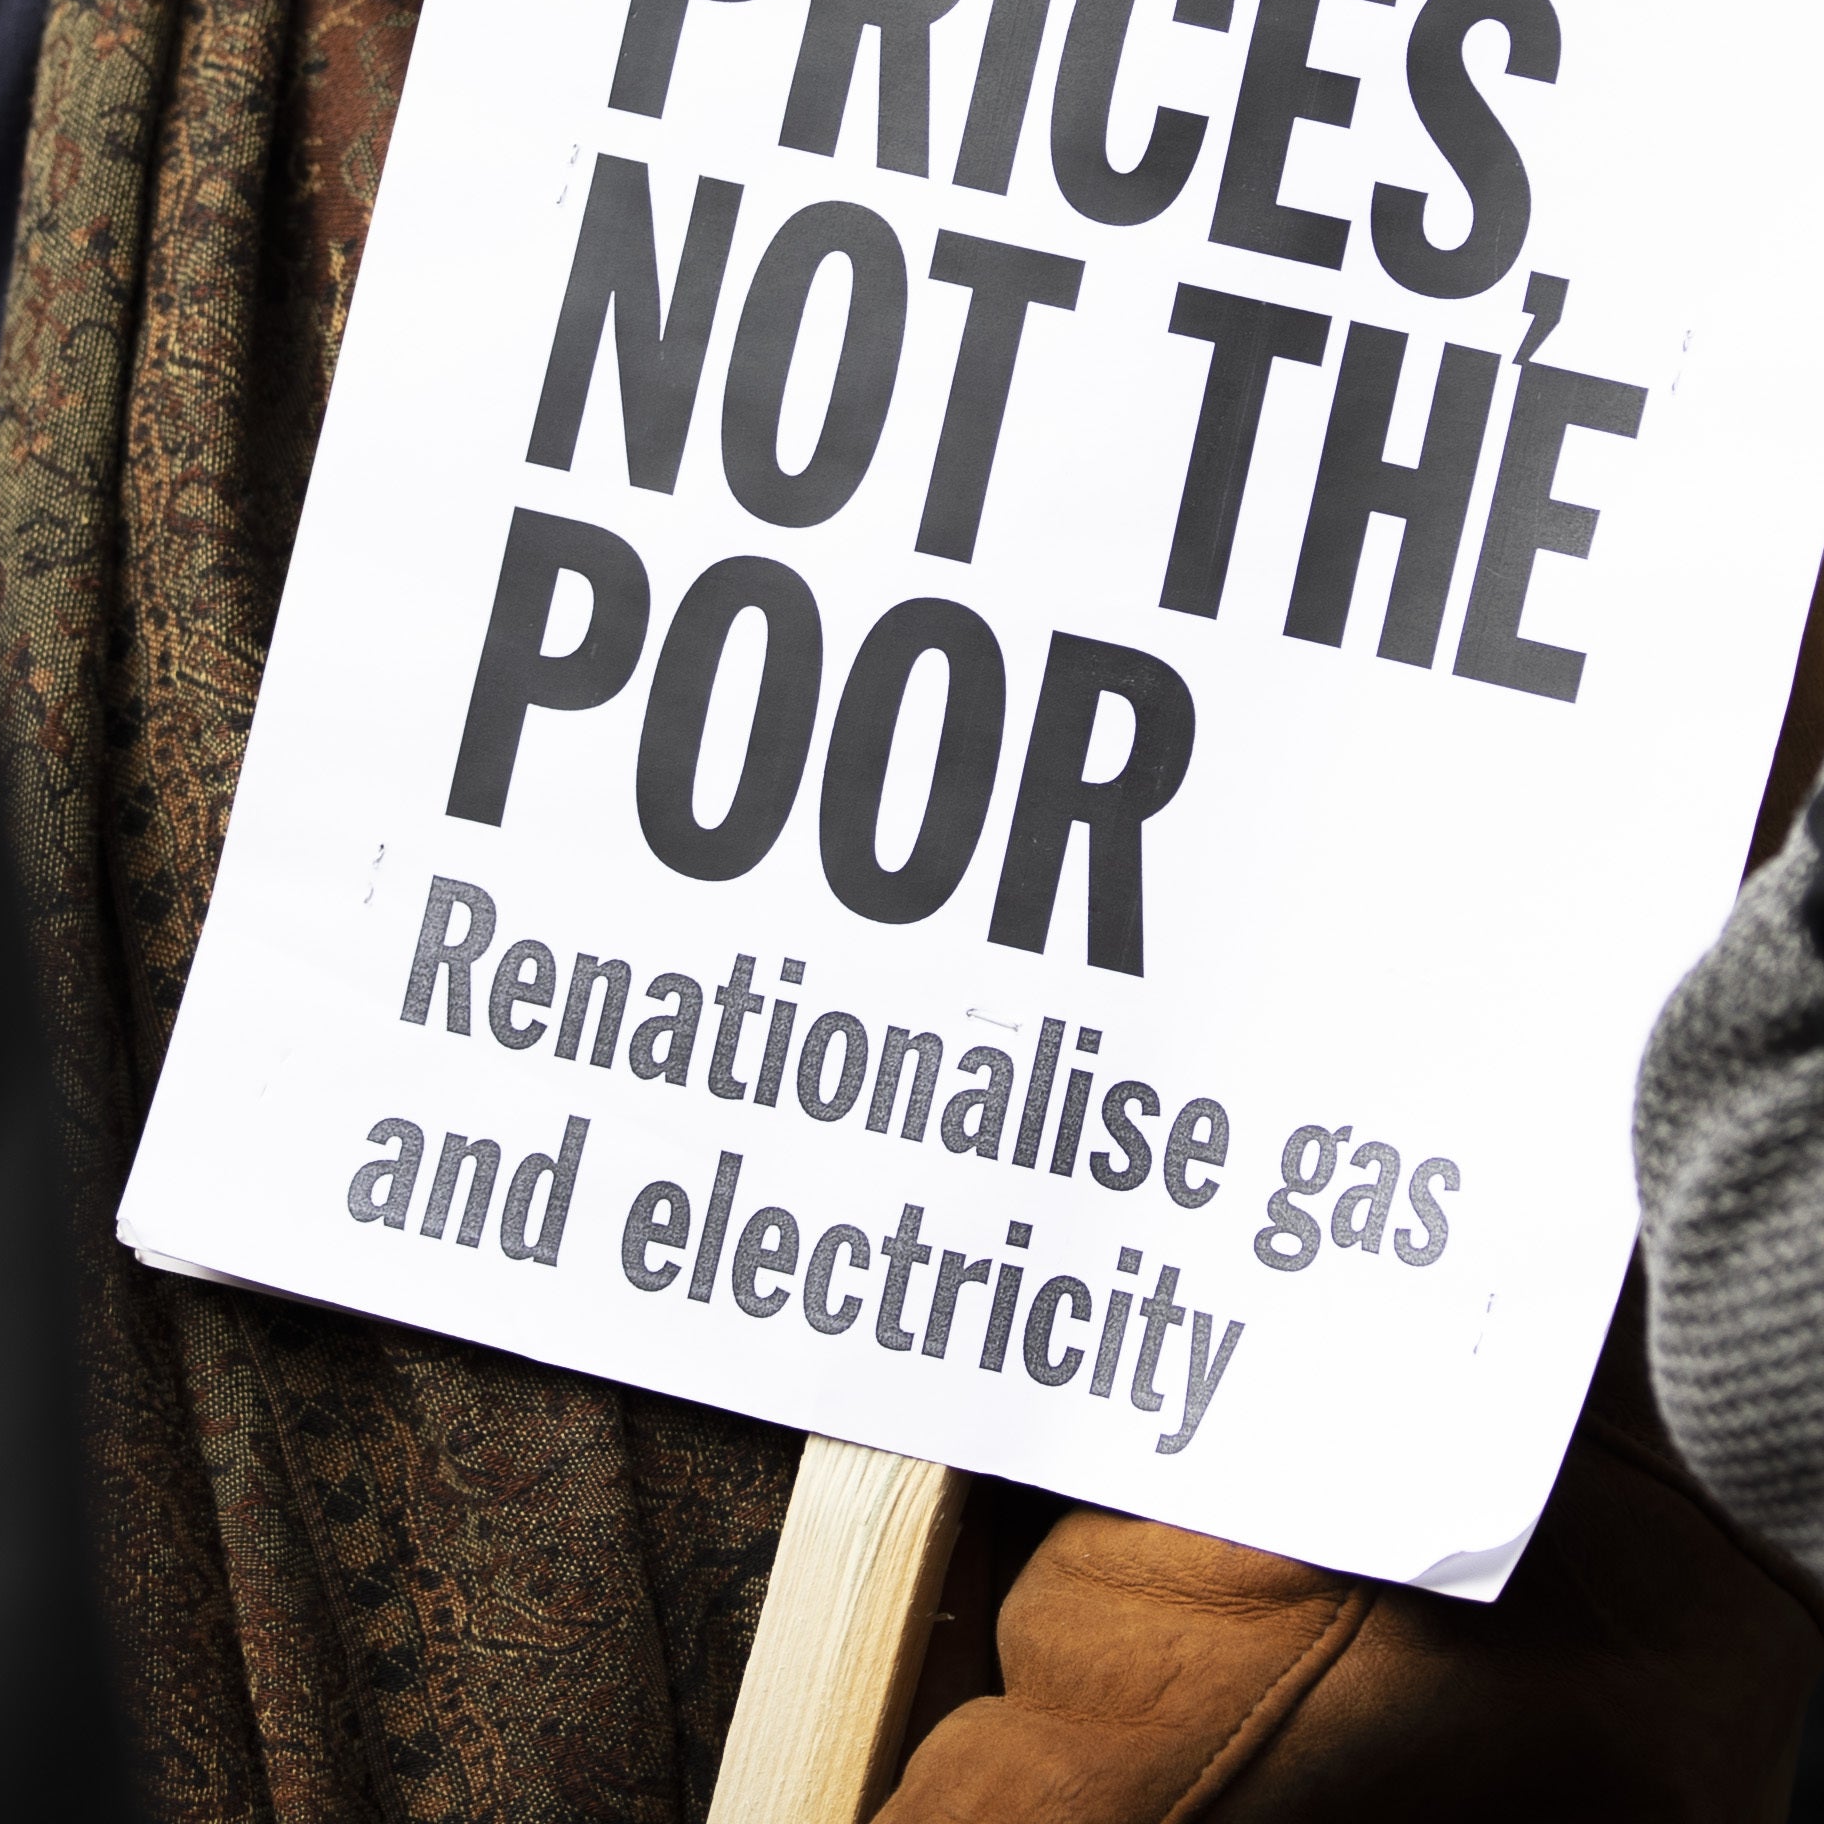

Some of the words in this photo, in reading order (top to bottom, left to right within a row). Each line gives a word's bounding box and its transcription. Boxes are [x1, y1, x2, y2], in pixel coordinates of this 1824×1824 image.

[525, 152, 1086, 565] NOT
[1158, 281, 1649, 704] THE
[445, 506, 1196, 979] POOR
[347, 1114, 591, 1268] and
[621, 1150, 1246, 1456] electricity
[399, 874, 1230, 1210] Renationalise
[1253, 1120, 1462, 1274] gas
